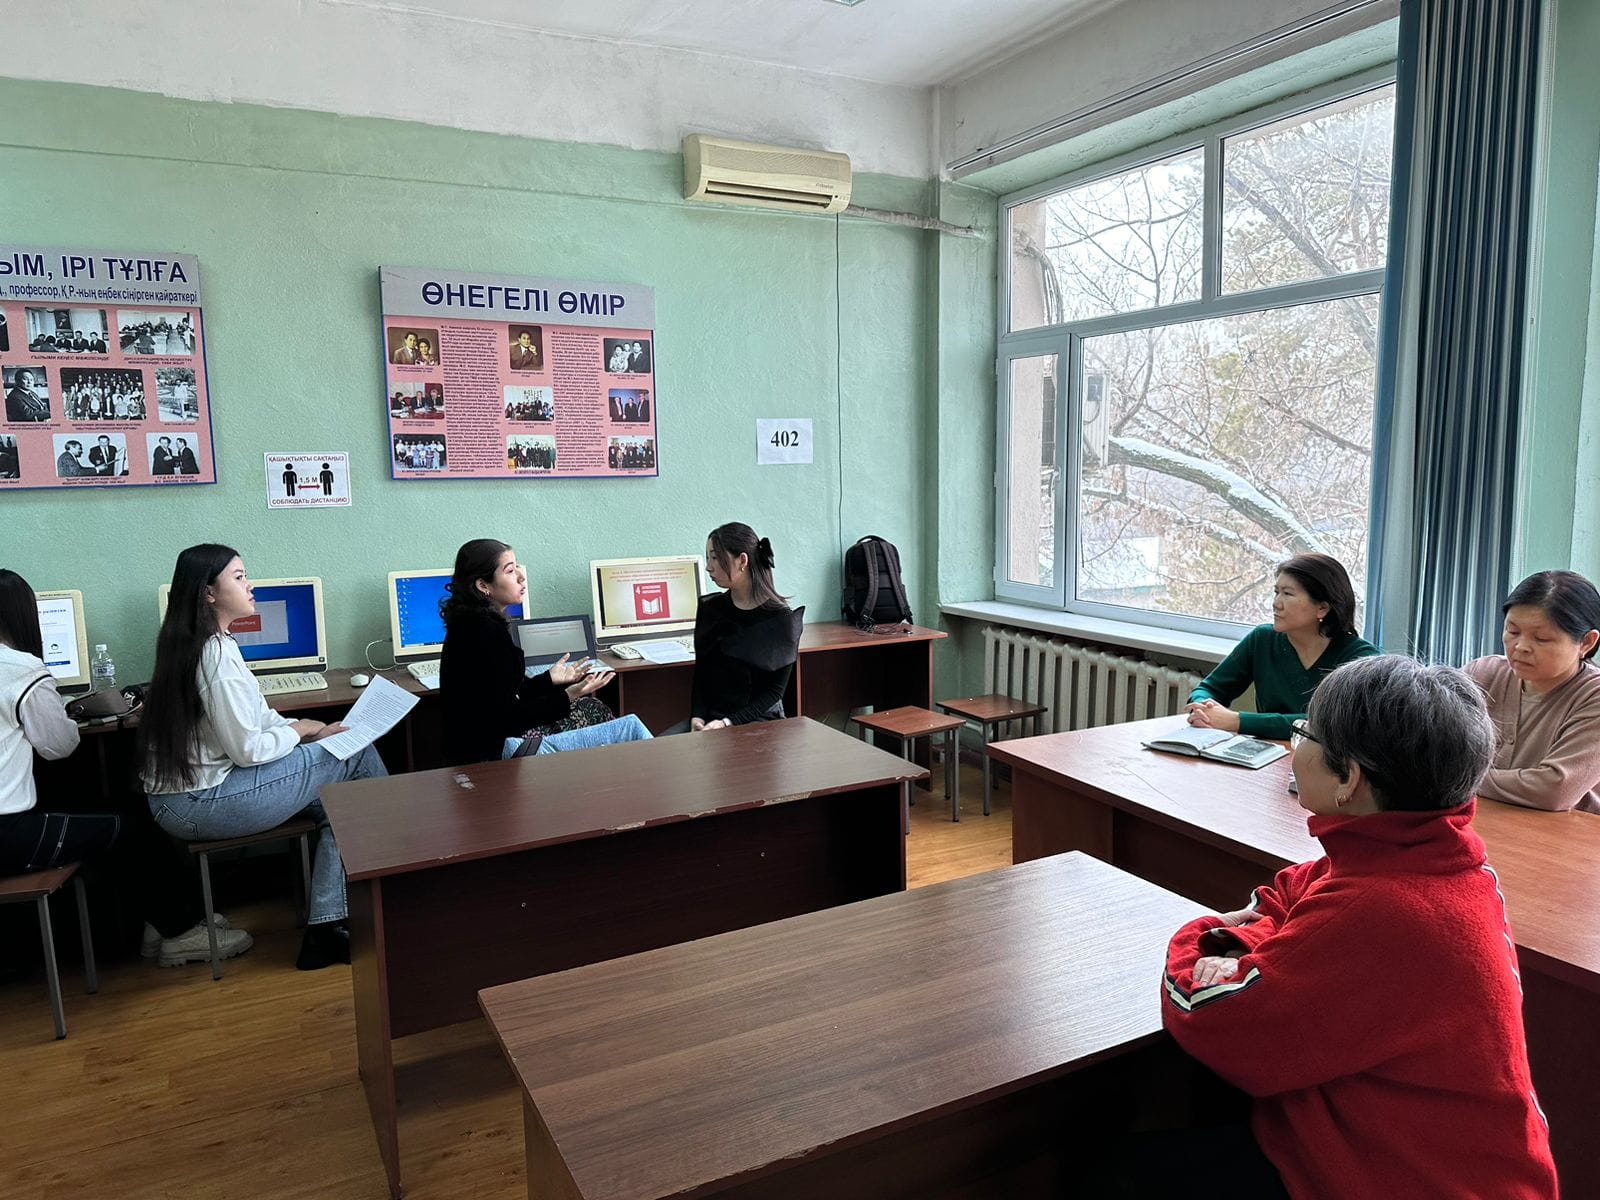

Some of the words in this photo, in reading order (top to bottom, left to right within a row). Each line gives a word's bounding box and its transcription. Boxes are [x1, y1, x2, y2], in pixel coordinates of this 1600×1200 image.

[61, 255, 95, 279] ІРІ
[102, 258, 188, 283] ТҰЛҒА
[97, 287, 122, 300] еңбек
[122, 288, 156, 302] сіңірген
[156, 290, 198, 304] қайраткері
[421, 281, 549, 312] ӨНЕГЕЛІ
[558, 291, 625, 316] ӨМІР
[770, 430, 799, 447] 402
[635, 586, 641, 594] 4
